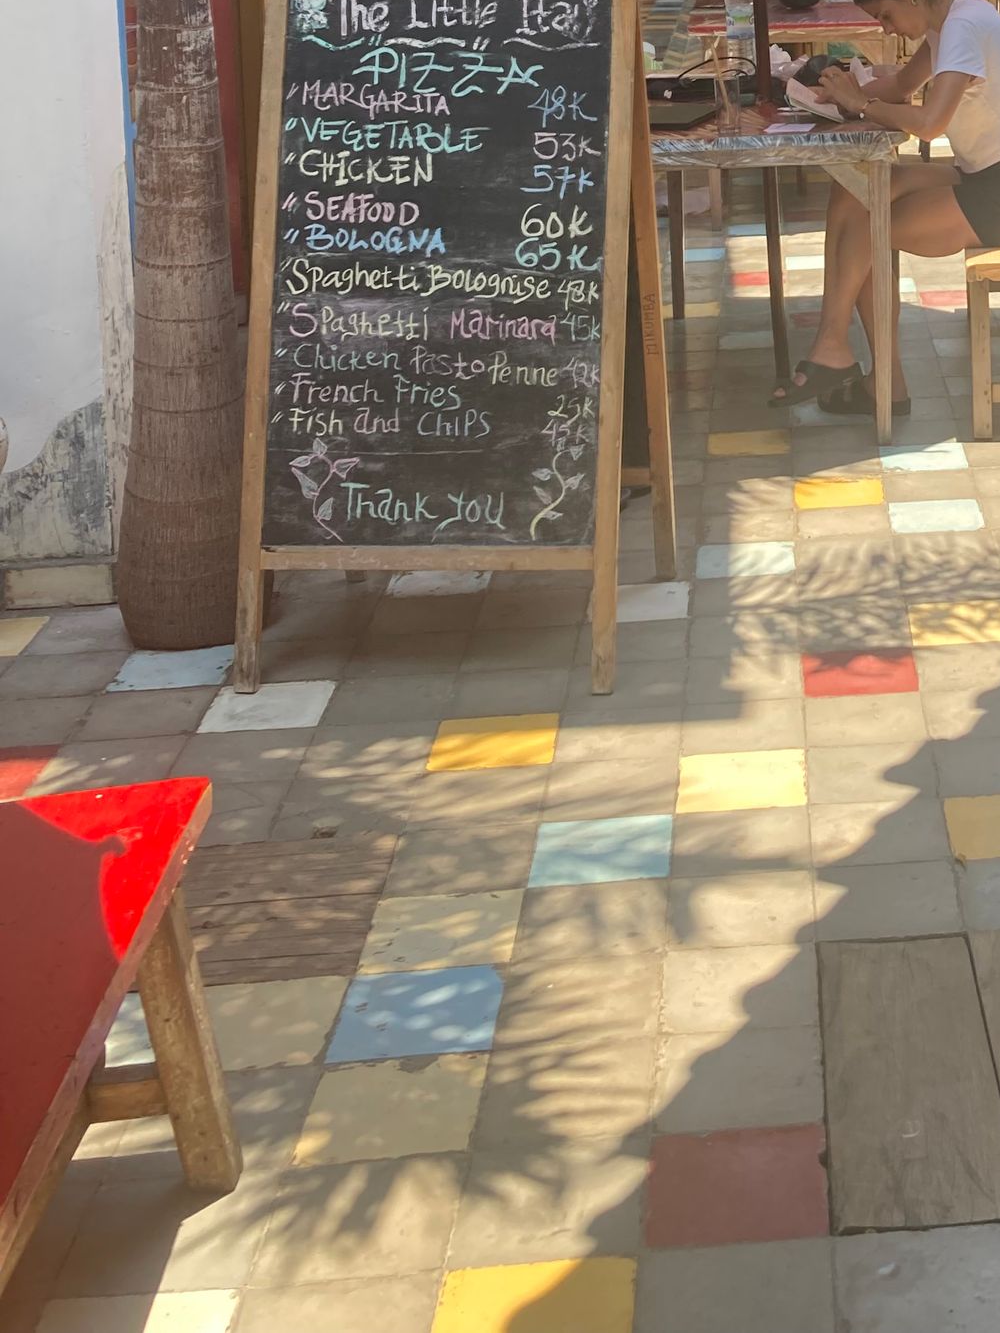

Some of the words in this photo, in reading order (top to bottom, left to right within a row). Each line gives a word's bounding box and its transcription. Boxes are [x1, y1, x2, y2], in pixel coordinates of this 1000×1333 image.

[352, 46, 544, 99] PIZZA
[302, 79, 451, 120] MARGARITA
[301, 116, 492, 154] VEGETABLE
[299, 149, 433, 187] CHICKEN
[304, 191, 420, 227] SEAFOOD
[304, 223, 447, 256] BOLOGNA
[450, 308, 556, 346] Marinara
[293, 343, 399, 372] Chicken
[487, 350, 559, 386] Penne
[289, 372, 385, 404] French
[393, 374, 462, 411] Fries
[288, 408, 344, 436] Fish
[340, 482, 438, 525] Thank
